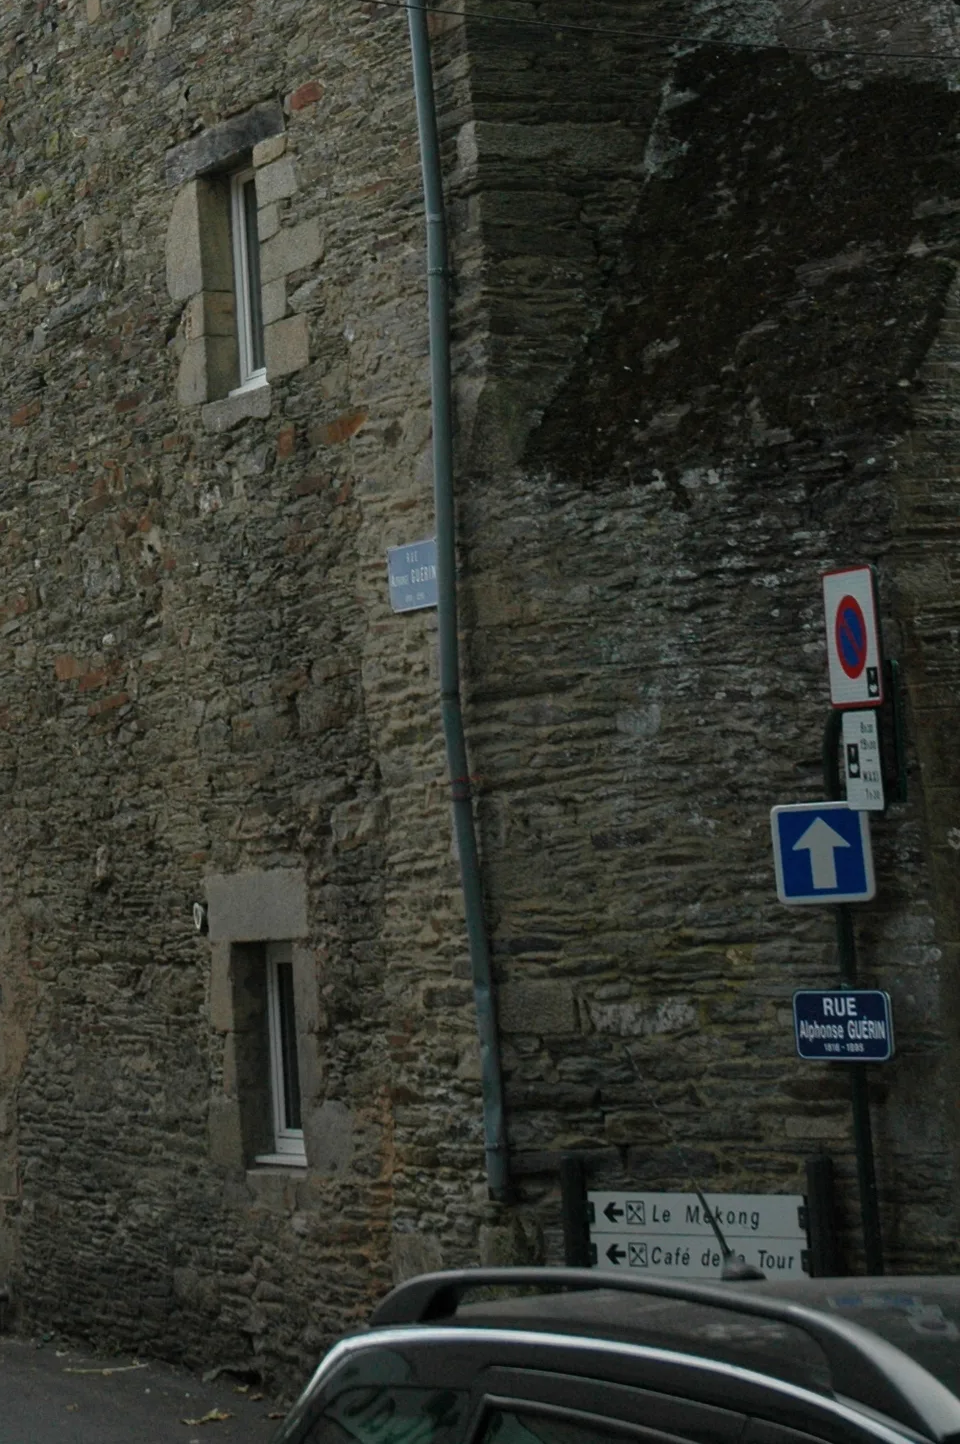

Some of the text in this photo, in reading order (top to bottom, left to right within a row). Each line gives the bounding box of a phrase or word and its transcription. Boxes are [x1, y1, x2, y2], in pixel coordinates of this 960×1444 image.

[822, 997, 858, 1016] RUE
[800, 1015, 886, 1043] Alphonse GUÉRIN
[652, 1204, 671, 1223] Le
[651, 1246, 690, 1266] Café
[701, 1248, 720, 1267] de
[757, 1250, 795, 1269] Tour
